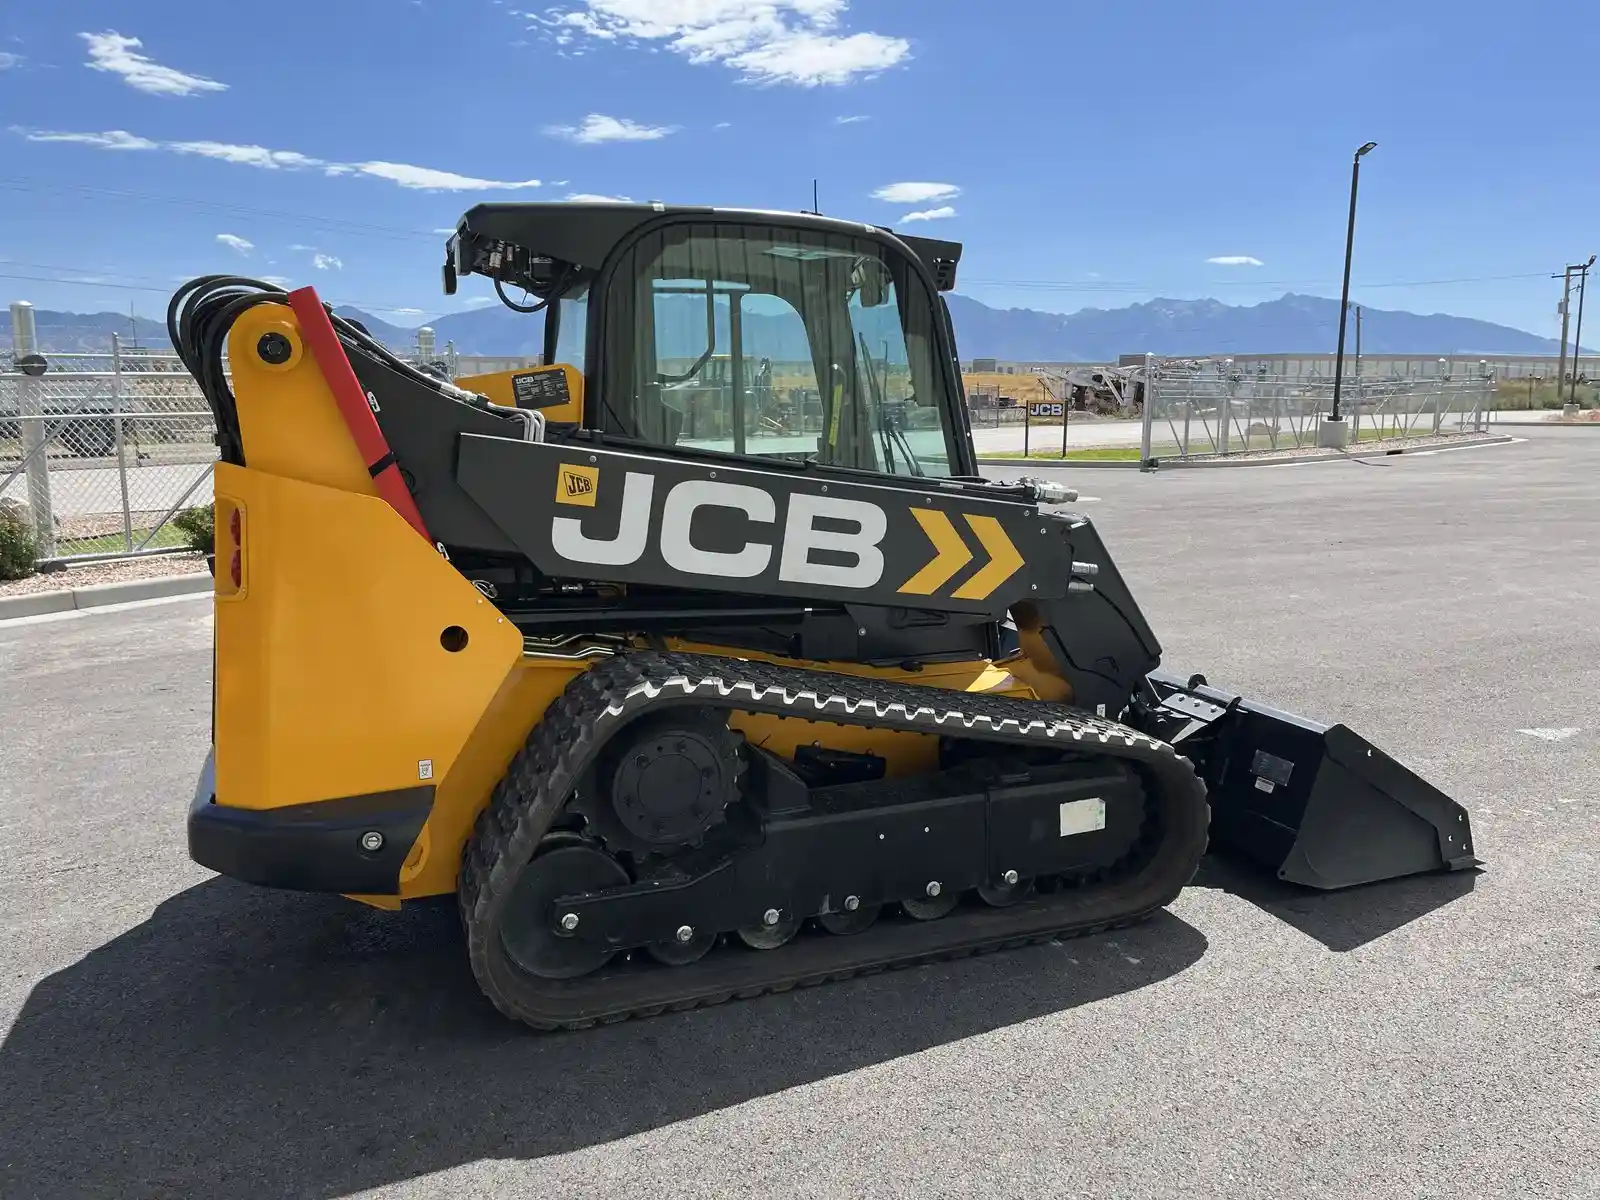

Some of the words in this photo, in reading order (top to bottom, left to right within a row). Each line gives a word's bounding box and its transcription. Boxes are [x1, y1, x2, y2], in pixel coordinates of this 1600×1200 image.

[1030, 404, 1062, 416] JCB
[568, 474, 591, 495] JCB
[551, 471, 888, 589] JCB
